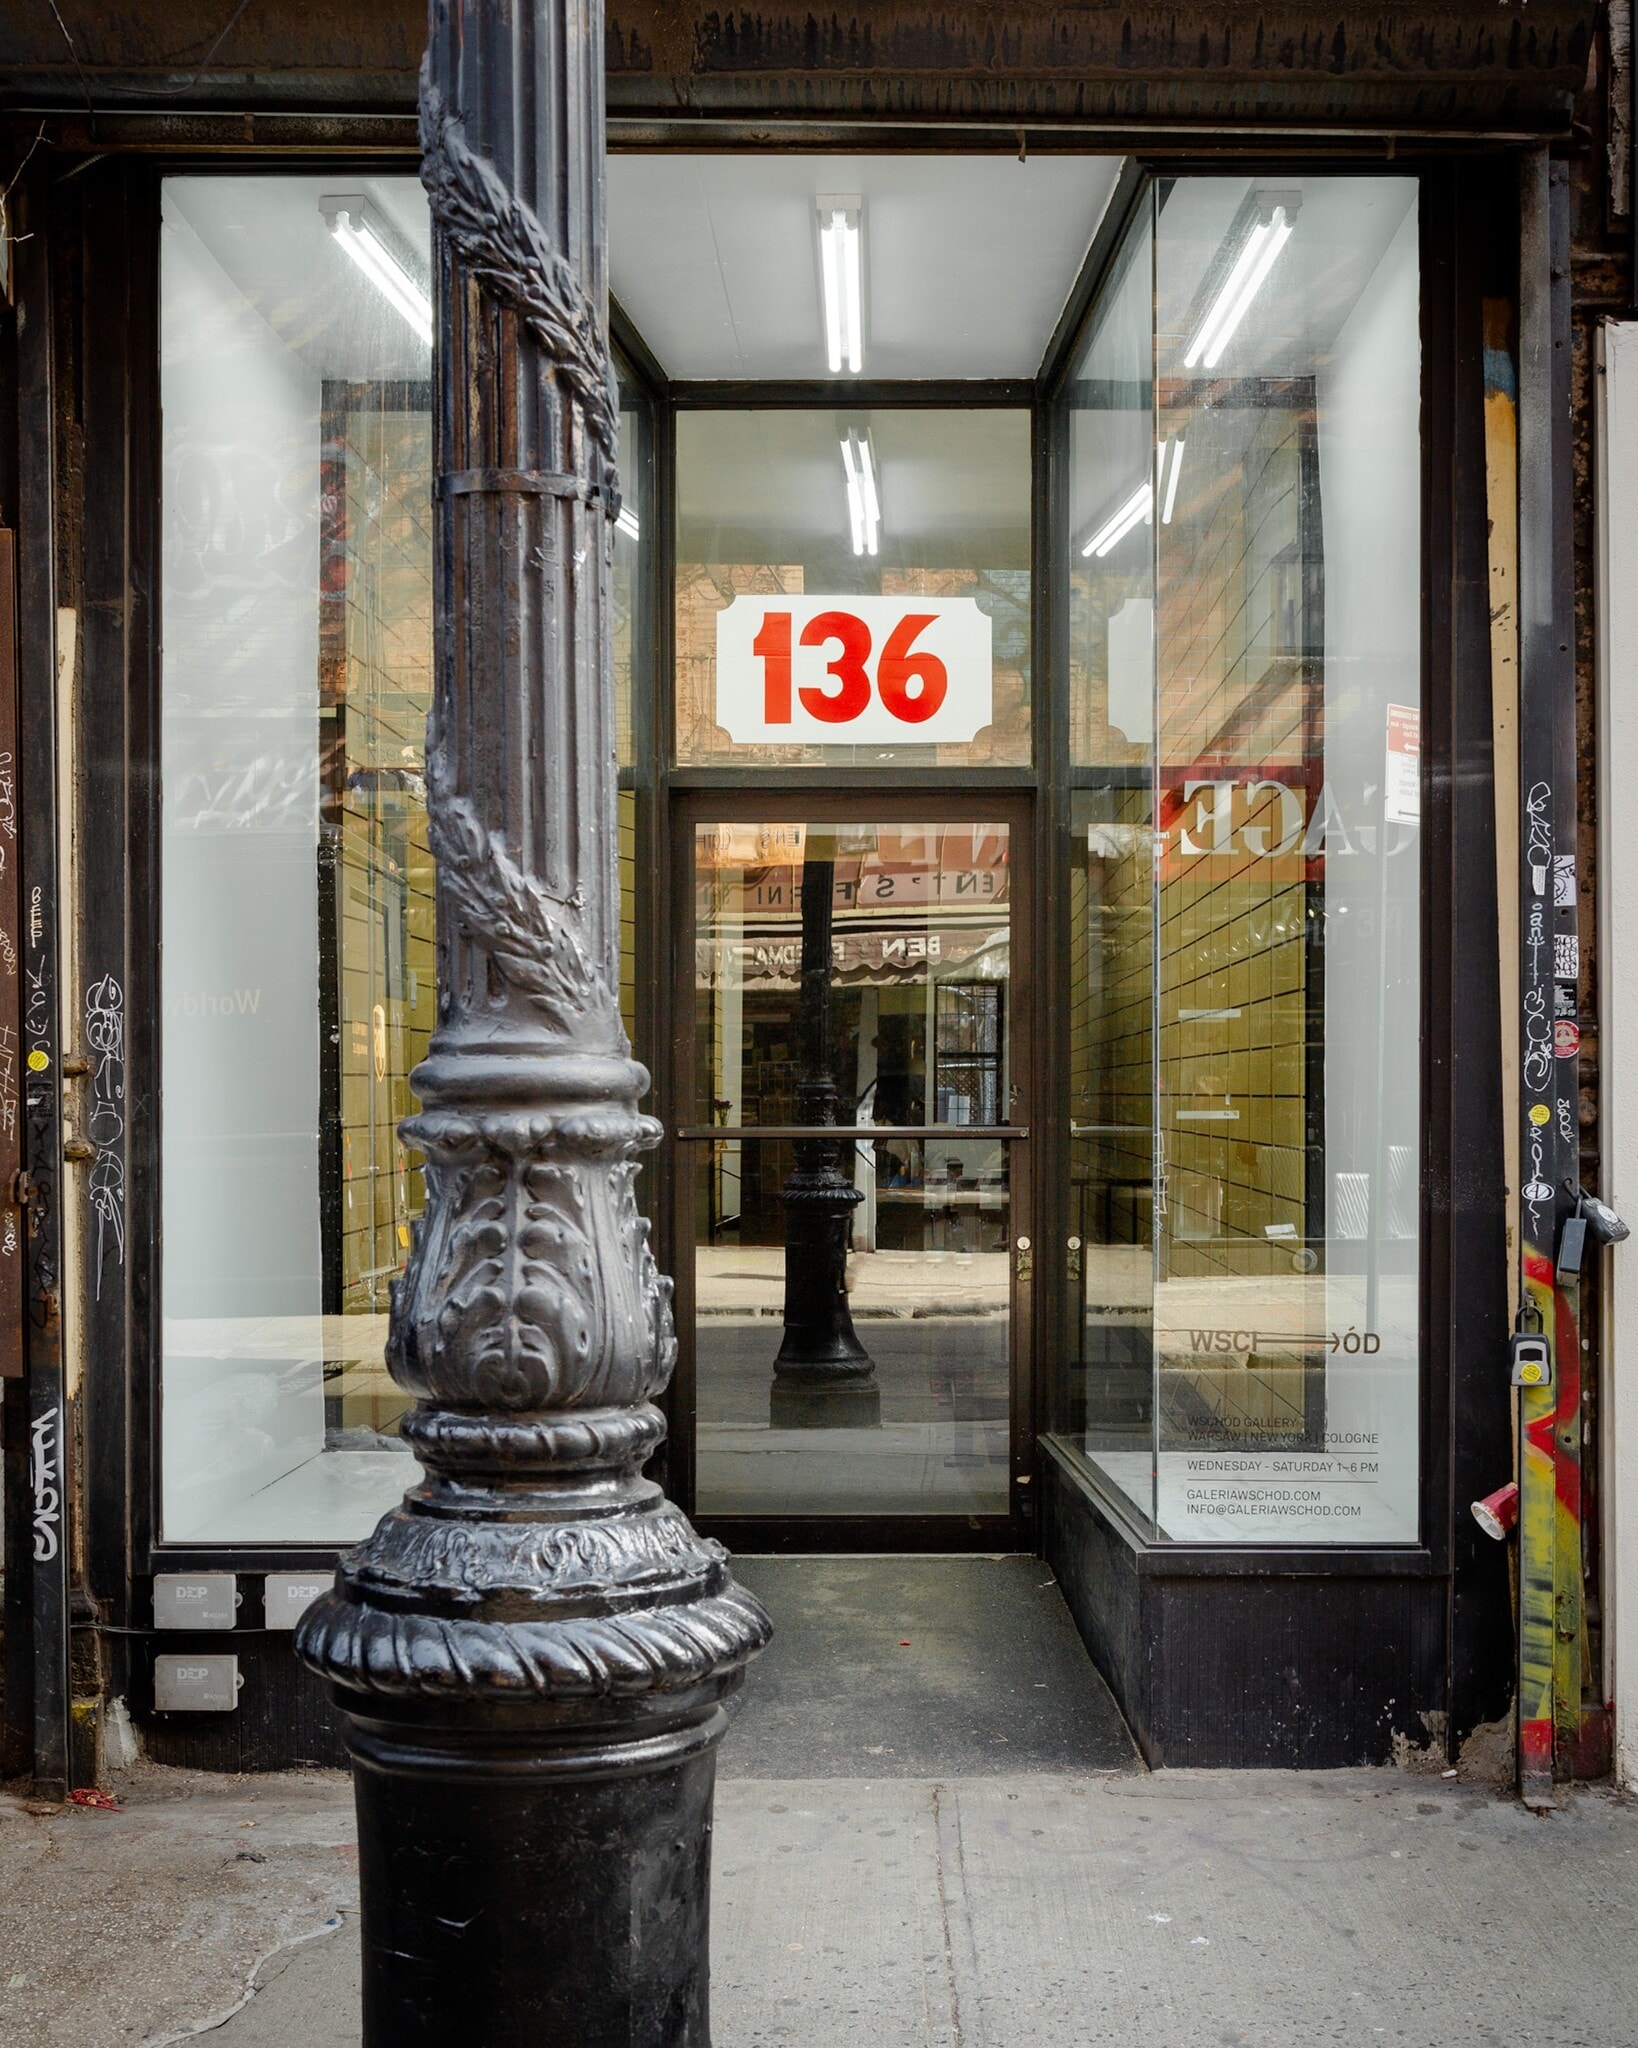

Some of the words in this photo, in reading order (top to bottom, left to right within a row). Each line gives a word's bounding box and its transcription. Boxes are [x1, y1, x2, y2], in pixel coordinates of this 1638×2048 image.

[753, 610, 949, 725] 136
[1244, 1417, 1297, 1428] GALLERY
[1187, 1431, 1241, 1443] WARSAW
[1250, 1432, 1279, 1443] NEW
[1280, 1432, 1311, 1443] YORK
[1323, 1433, 1379, 1444] COLOGNE
[1187, 1460, 1262, 1471] WEDNESDAY
[1272, 1461, 1334, 1472] SATURDAY
[1360, 1462, 1379, 1473] PM
[1186, 1489, 1321, 1501] GALERIAWSCHOD.COM
[1186, 1504, 1361, 1516] INFO@GALERIAWSCHOD.COM
